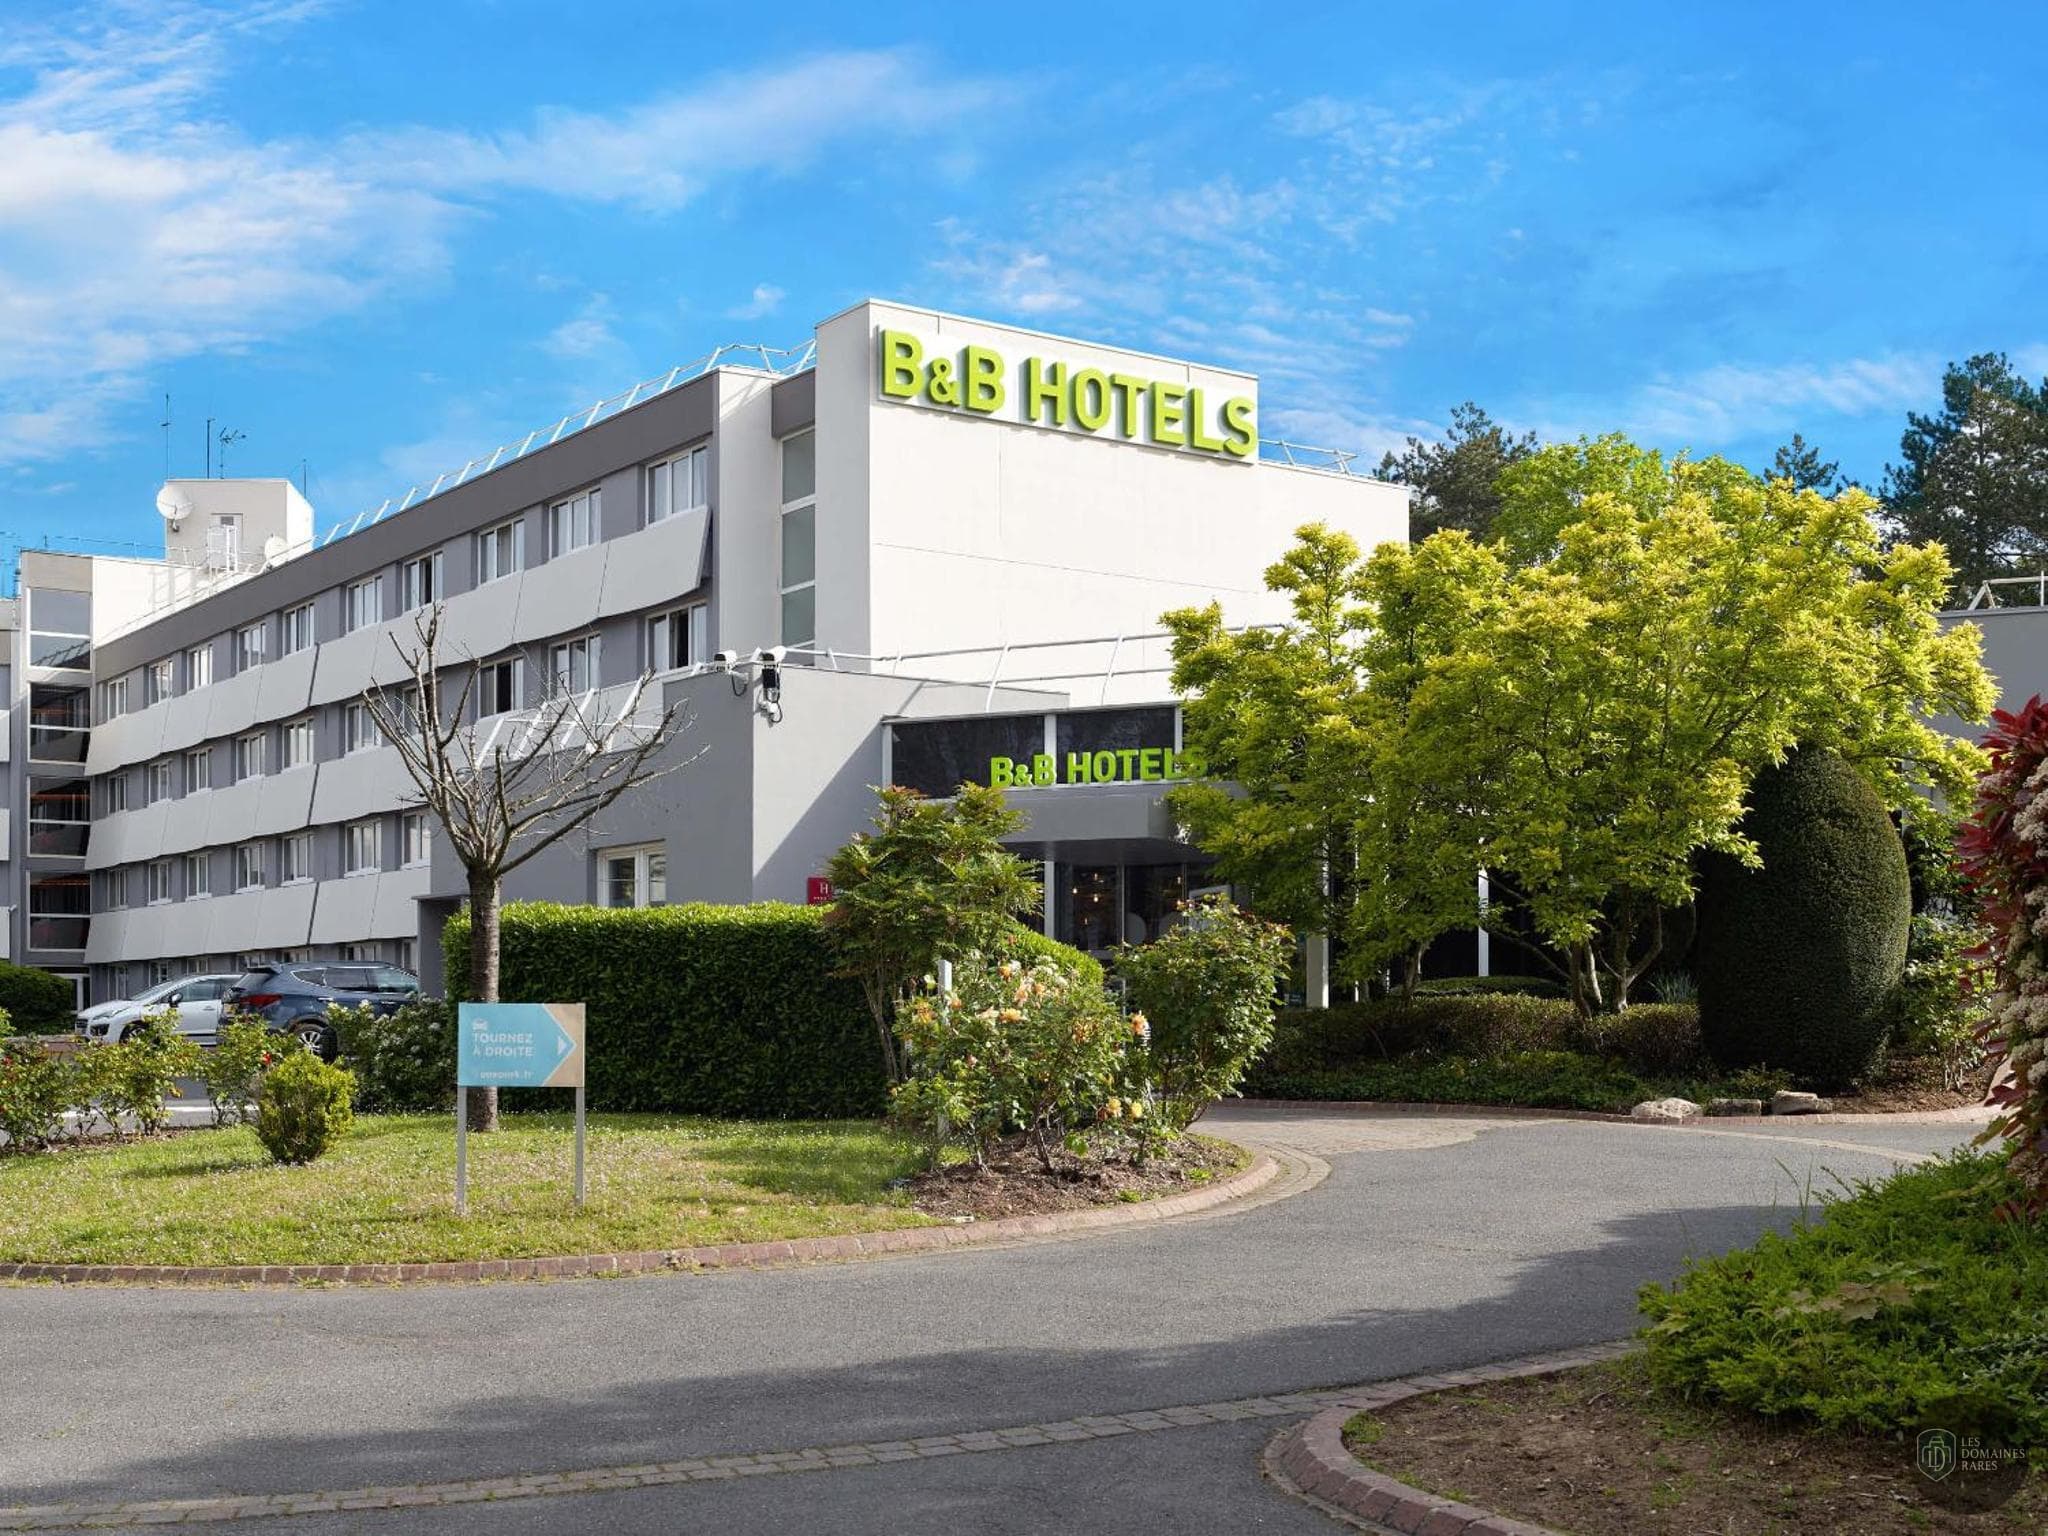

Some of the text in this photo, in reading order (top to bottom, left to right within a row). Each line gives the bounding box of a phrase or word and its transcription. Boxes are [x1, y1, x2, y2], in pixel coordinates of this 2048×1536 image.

[881, 329, 1258, 458] B&B HOTELS
[990, 755, 1057, 788] B&B
[472, 1032, 534, 1044] TOURNEZ
[485, 1046, 535, 1057] DROITE
